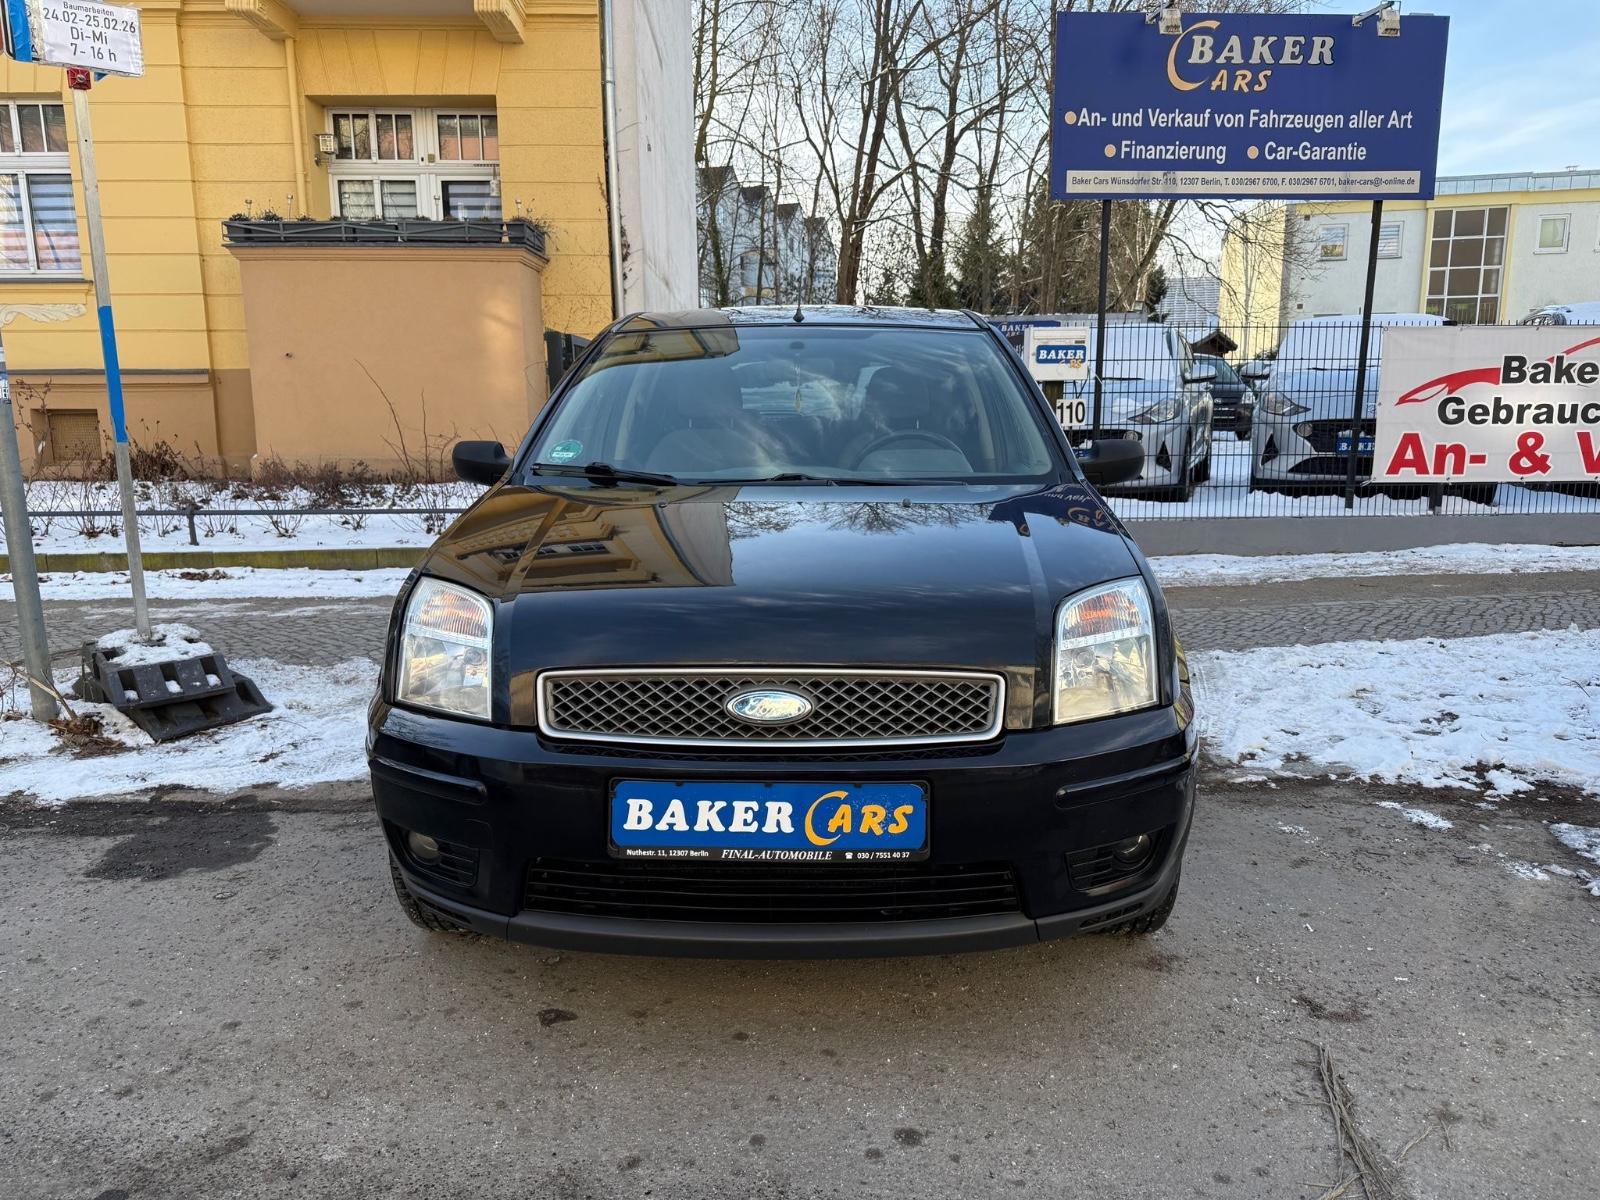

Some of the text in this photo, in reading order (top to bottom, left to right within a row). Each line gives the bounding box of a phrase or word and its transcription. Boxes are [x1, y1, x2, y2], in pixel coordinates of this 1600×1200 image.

[42, 7, 137, 33] 24.02-25.02.26
[63, 1, 115, 17] Baumarbeiten
[70, 26, 108, 45] Di-Mi
[108, 48, 117, 63] h
[1187, 35, 1336, 66] BAKER
[1078, 108, 1413, 133] An- und Verkauf von Fahrzeugen aller Art
[1121, 140, 1367, 164] Finanzierung Car-Garantie
[1072, 176, 1092, 185] Baker
[1093, 176, 1109, 185] Cars
[1110, 175, 1150, 185] Wünsdorfer
[1180, 177, 1200, 186] 12307
[1201, 177, 1222, 187] Berlin,
[1038, 349, 1084, 360] BAKER
[1501, 354, 1600, 385] Bake
[1057, 401, 1086, 424] 110
[1437, 396, 1600, 425] Gebrauc
[1385, 432, 1487, 475] An-
[1508, 431, 1552, 475] &
[623, 790, 914, 846] BAKER CARS
[626, 849, 656, 857] Nuthestr.
[657, 849, 667, 858] 11,
[669, 849, 688, 857] 12307
[689, 849, 709, 858] Berlin
[721, 849, 833, 861] FINAL-AUTOMOBILE
[857, 852, 870, 860] 030
[876, 852, 891, 860] 7551
[892, 851, 901, 859] 40
[902, 851, 910, 859] 37
